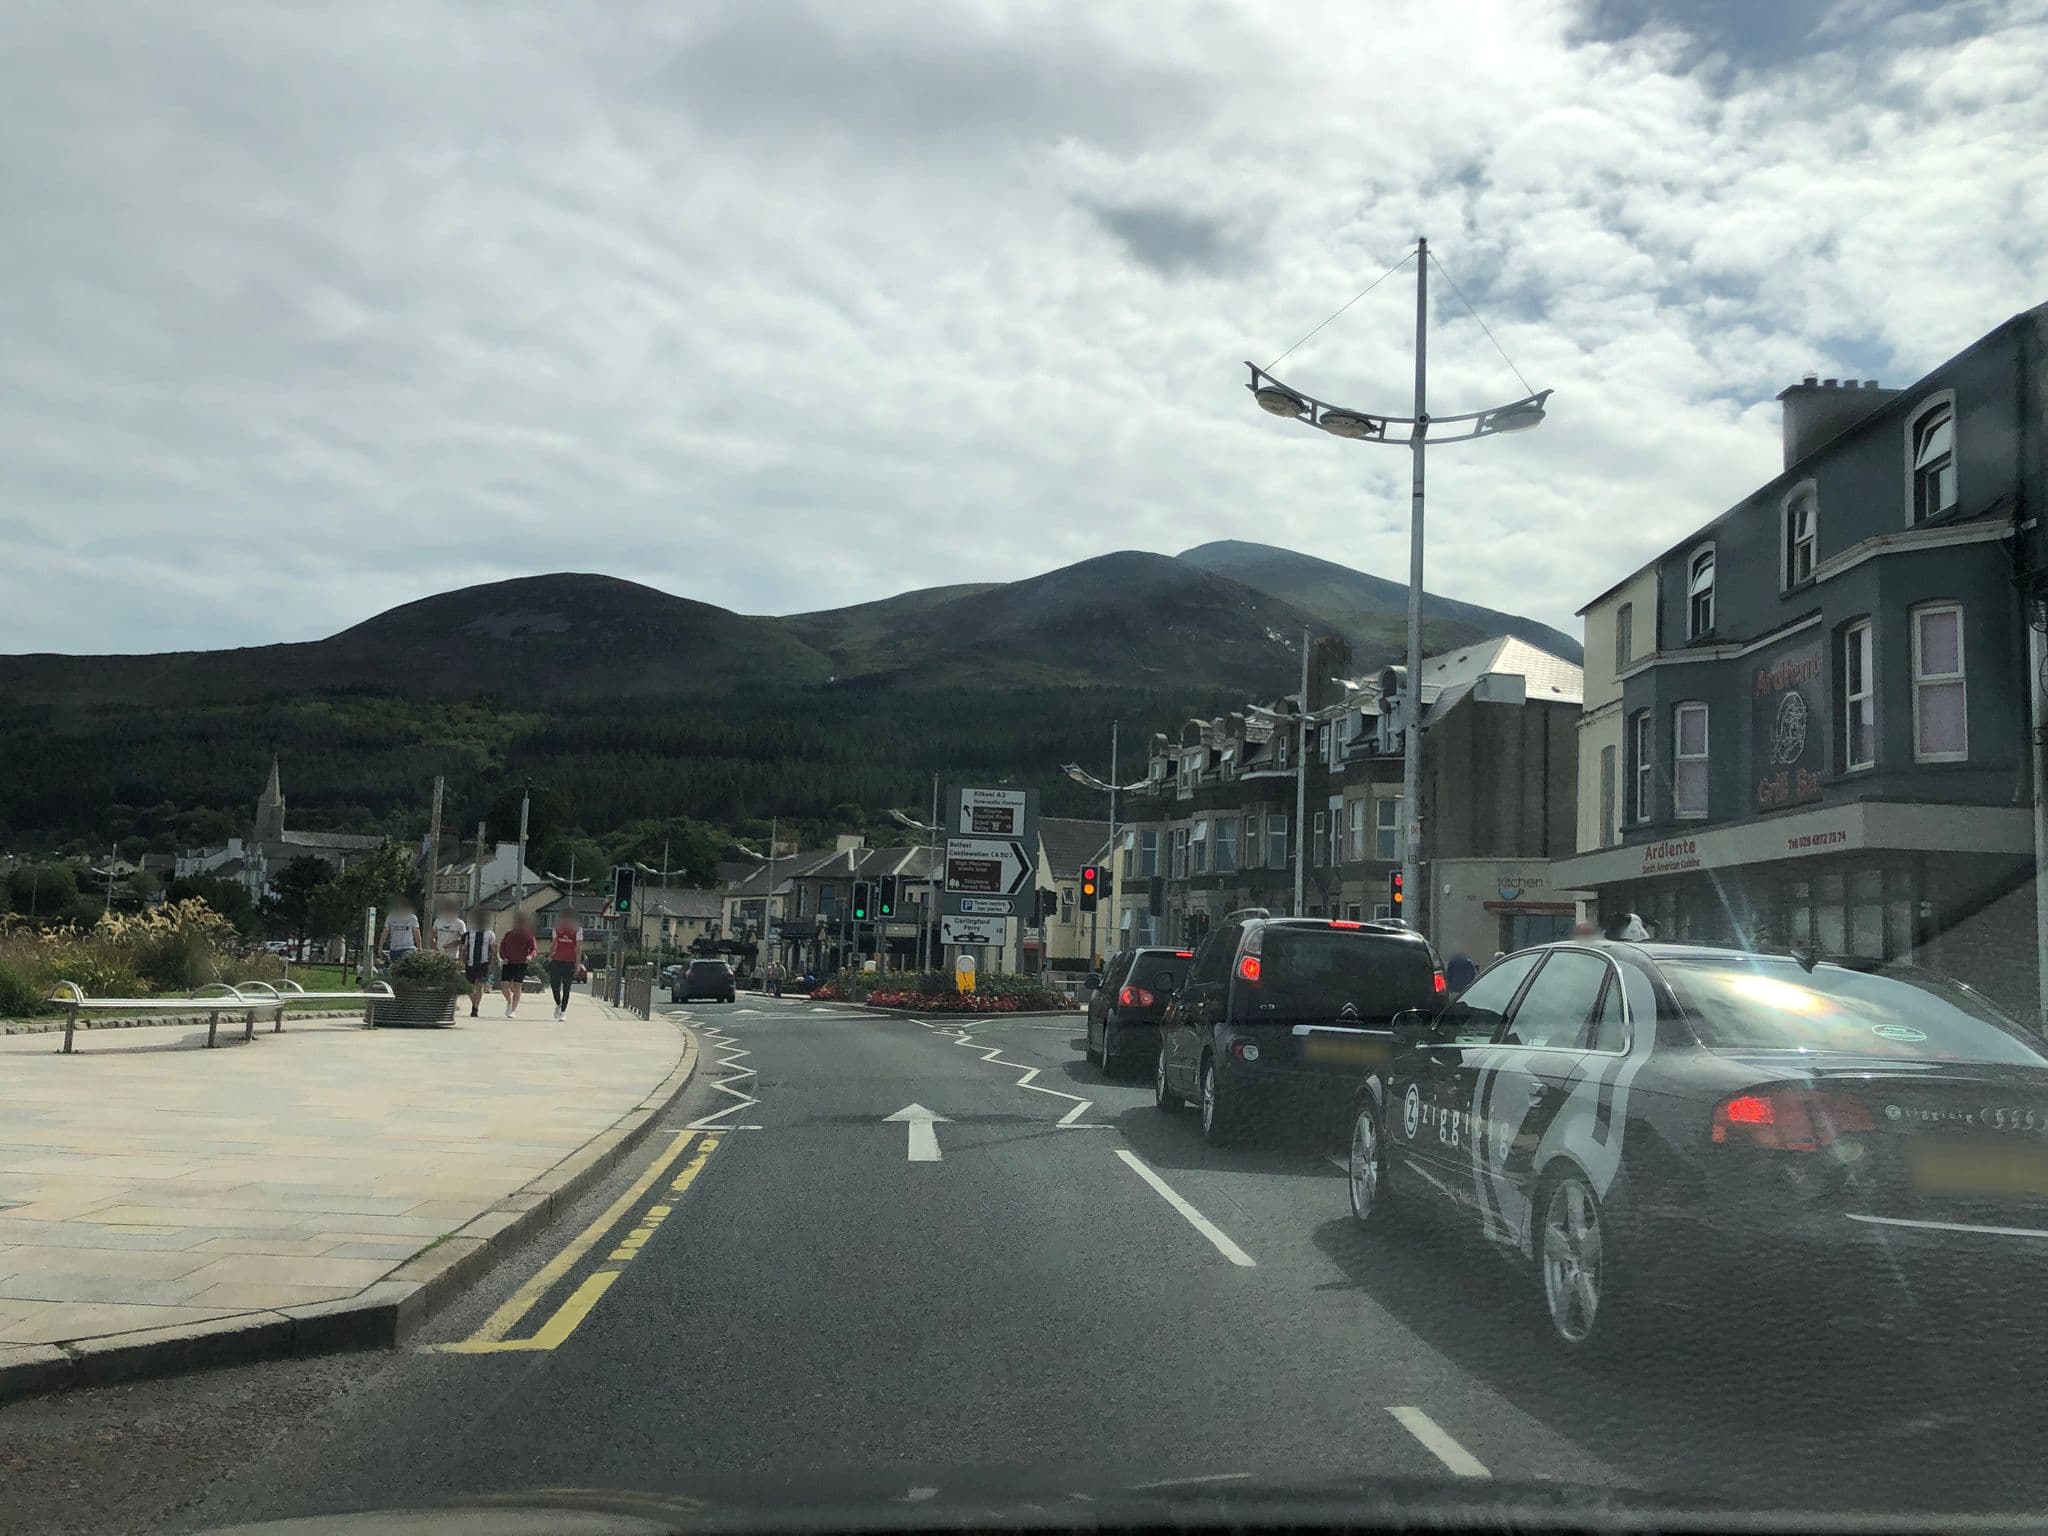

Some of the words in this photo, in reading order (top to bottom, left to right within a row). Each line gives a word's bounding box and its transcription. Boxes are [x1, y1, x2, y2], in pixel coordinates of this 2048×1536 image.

[949, 850, 989, 858] Castlewellan
[1645, 840, 1696, 861] Ardiente
[1498, 875, 1544, 889] kitchen
[954, 917, 991, 925] Carlingford
